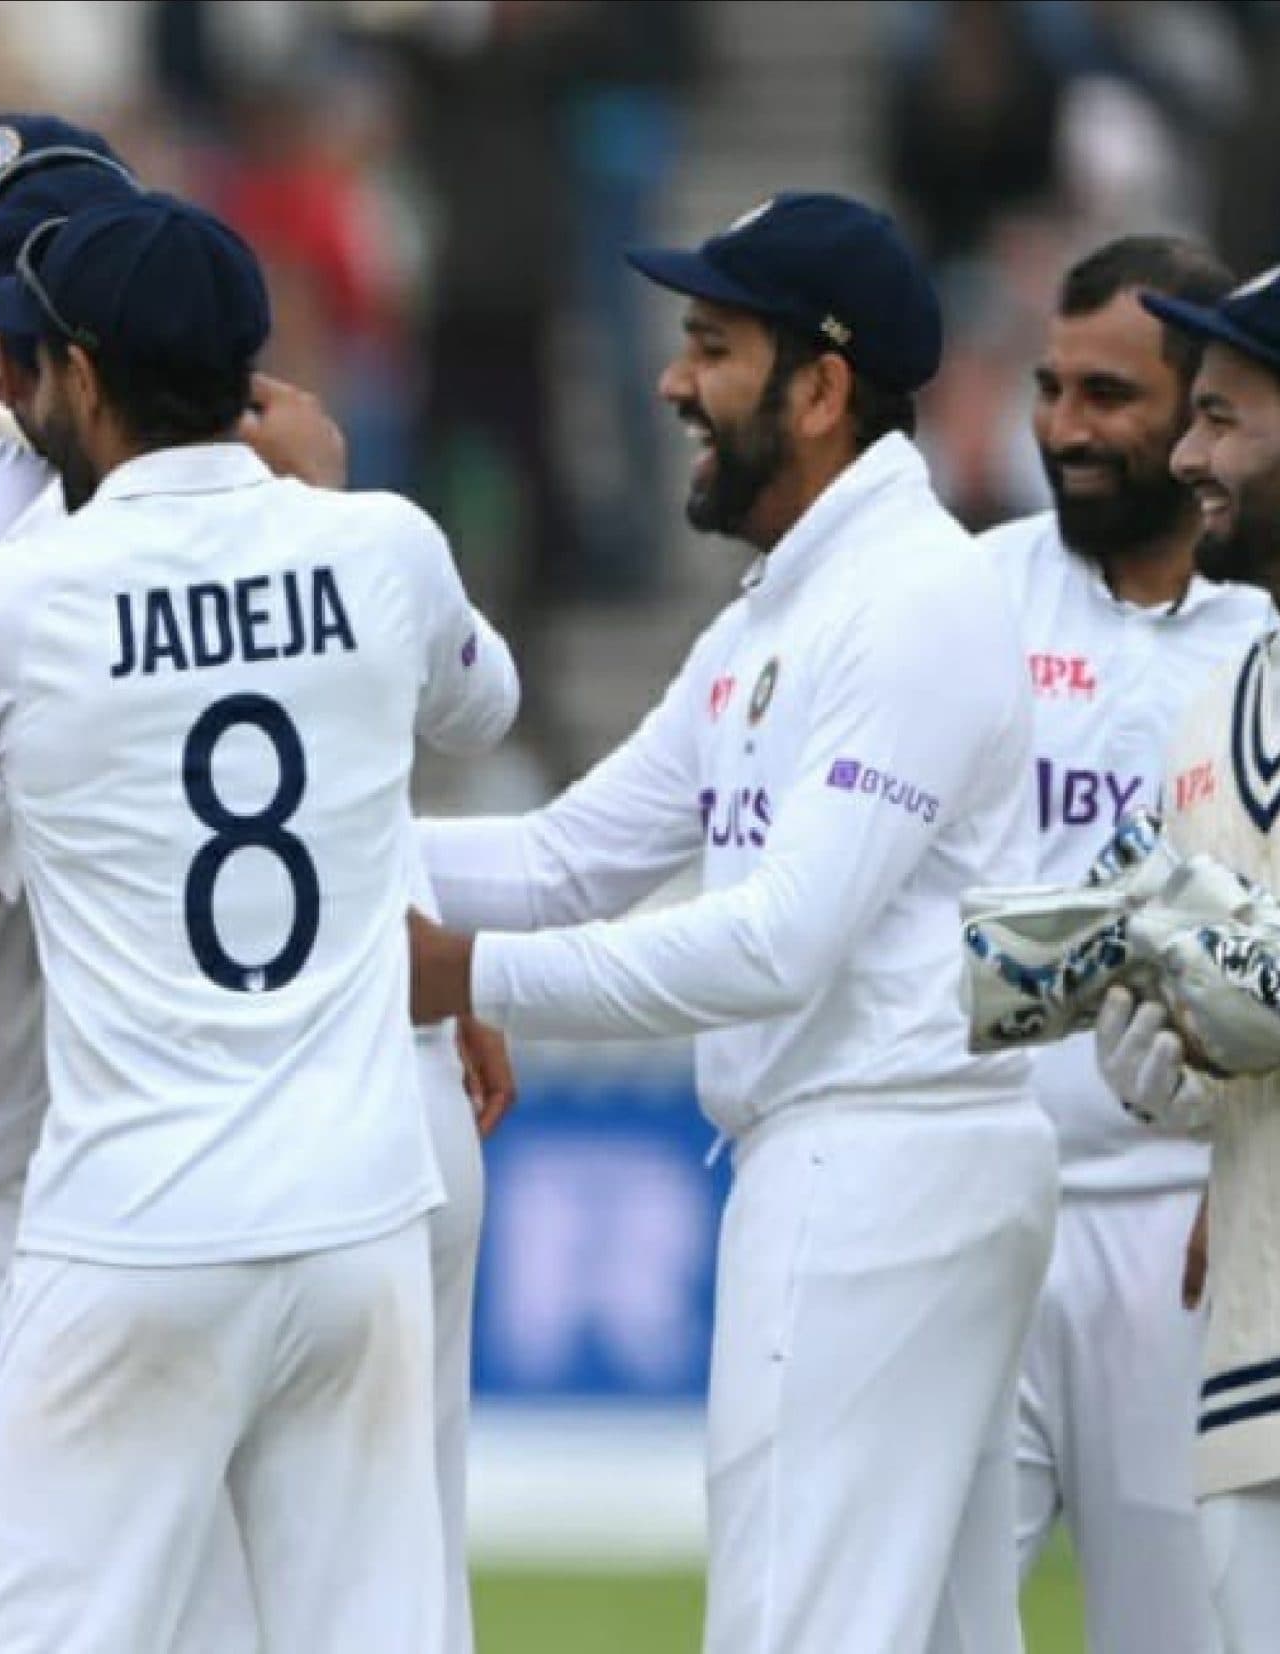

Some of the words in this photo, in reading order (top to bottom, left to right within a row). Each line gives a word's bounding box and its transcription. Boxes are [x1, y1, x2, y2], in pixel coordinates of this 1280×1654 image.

[111, 566, 357, 678] JADEJA
[182, 691, 320, 992] 8
[1062, 769, 1146, 826] BY
